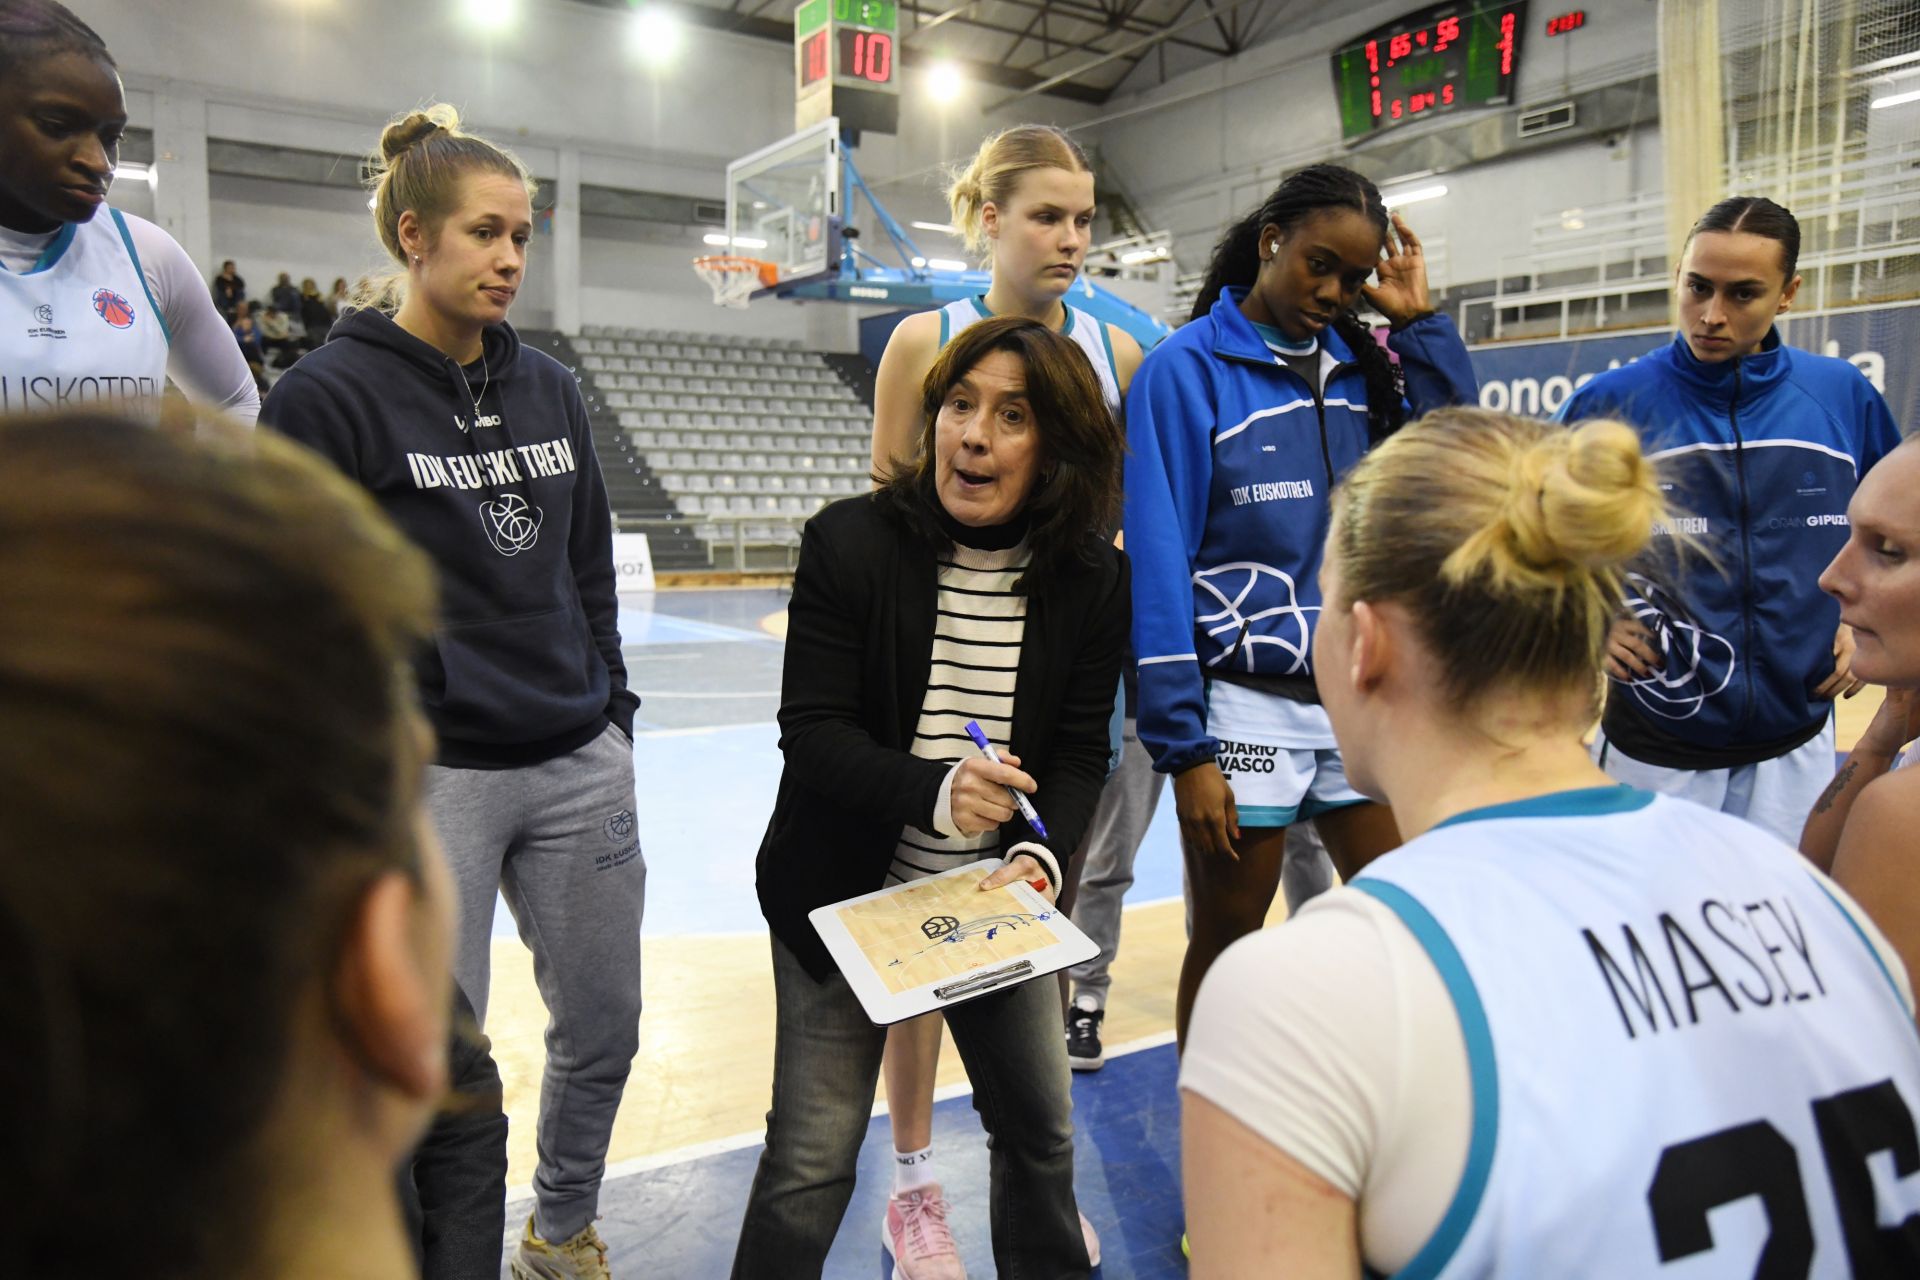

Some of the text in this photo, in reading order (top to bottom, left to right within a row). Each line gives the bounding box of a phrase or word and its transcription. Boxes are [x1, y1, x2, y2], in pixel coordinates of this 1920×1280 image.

[853, 33, 892, 83] 10
[406, 452, 455, 489] IDK
[1230, 479, 1314, 506] IDK EUSKOTREN
[1217, 740, 1278, 757] DIARIO
[1218, 755, 1275, 774] VASCO
